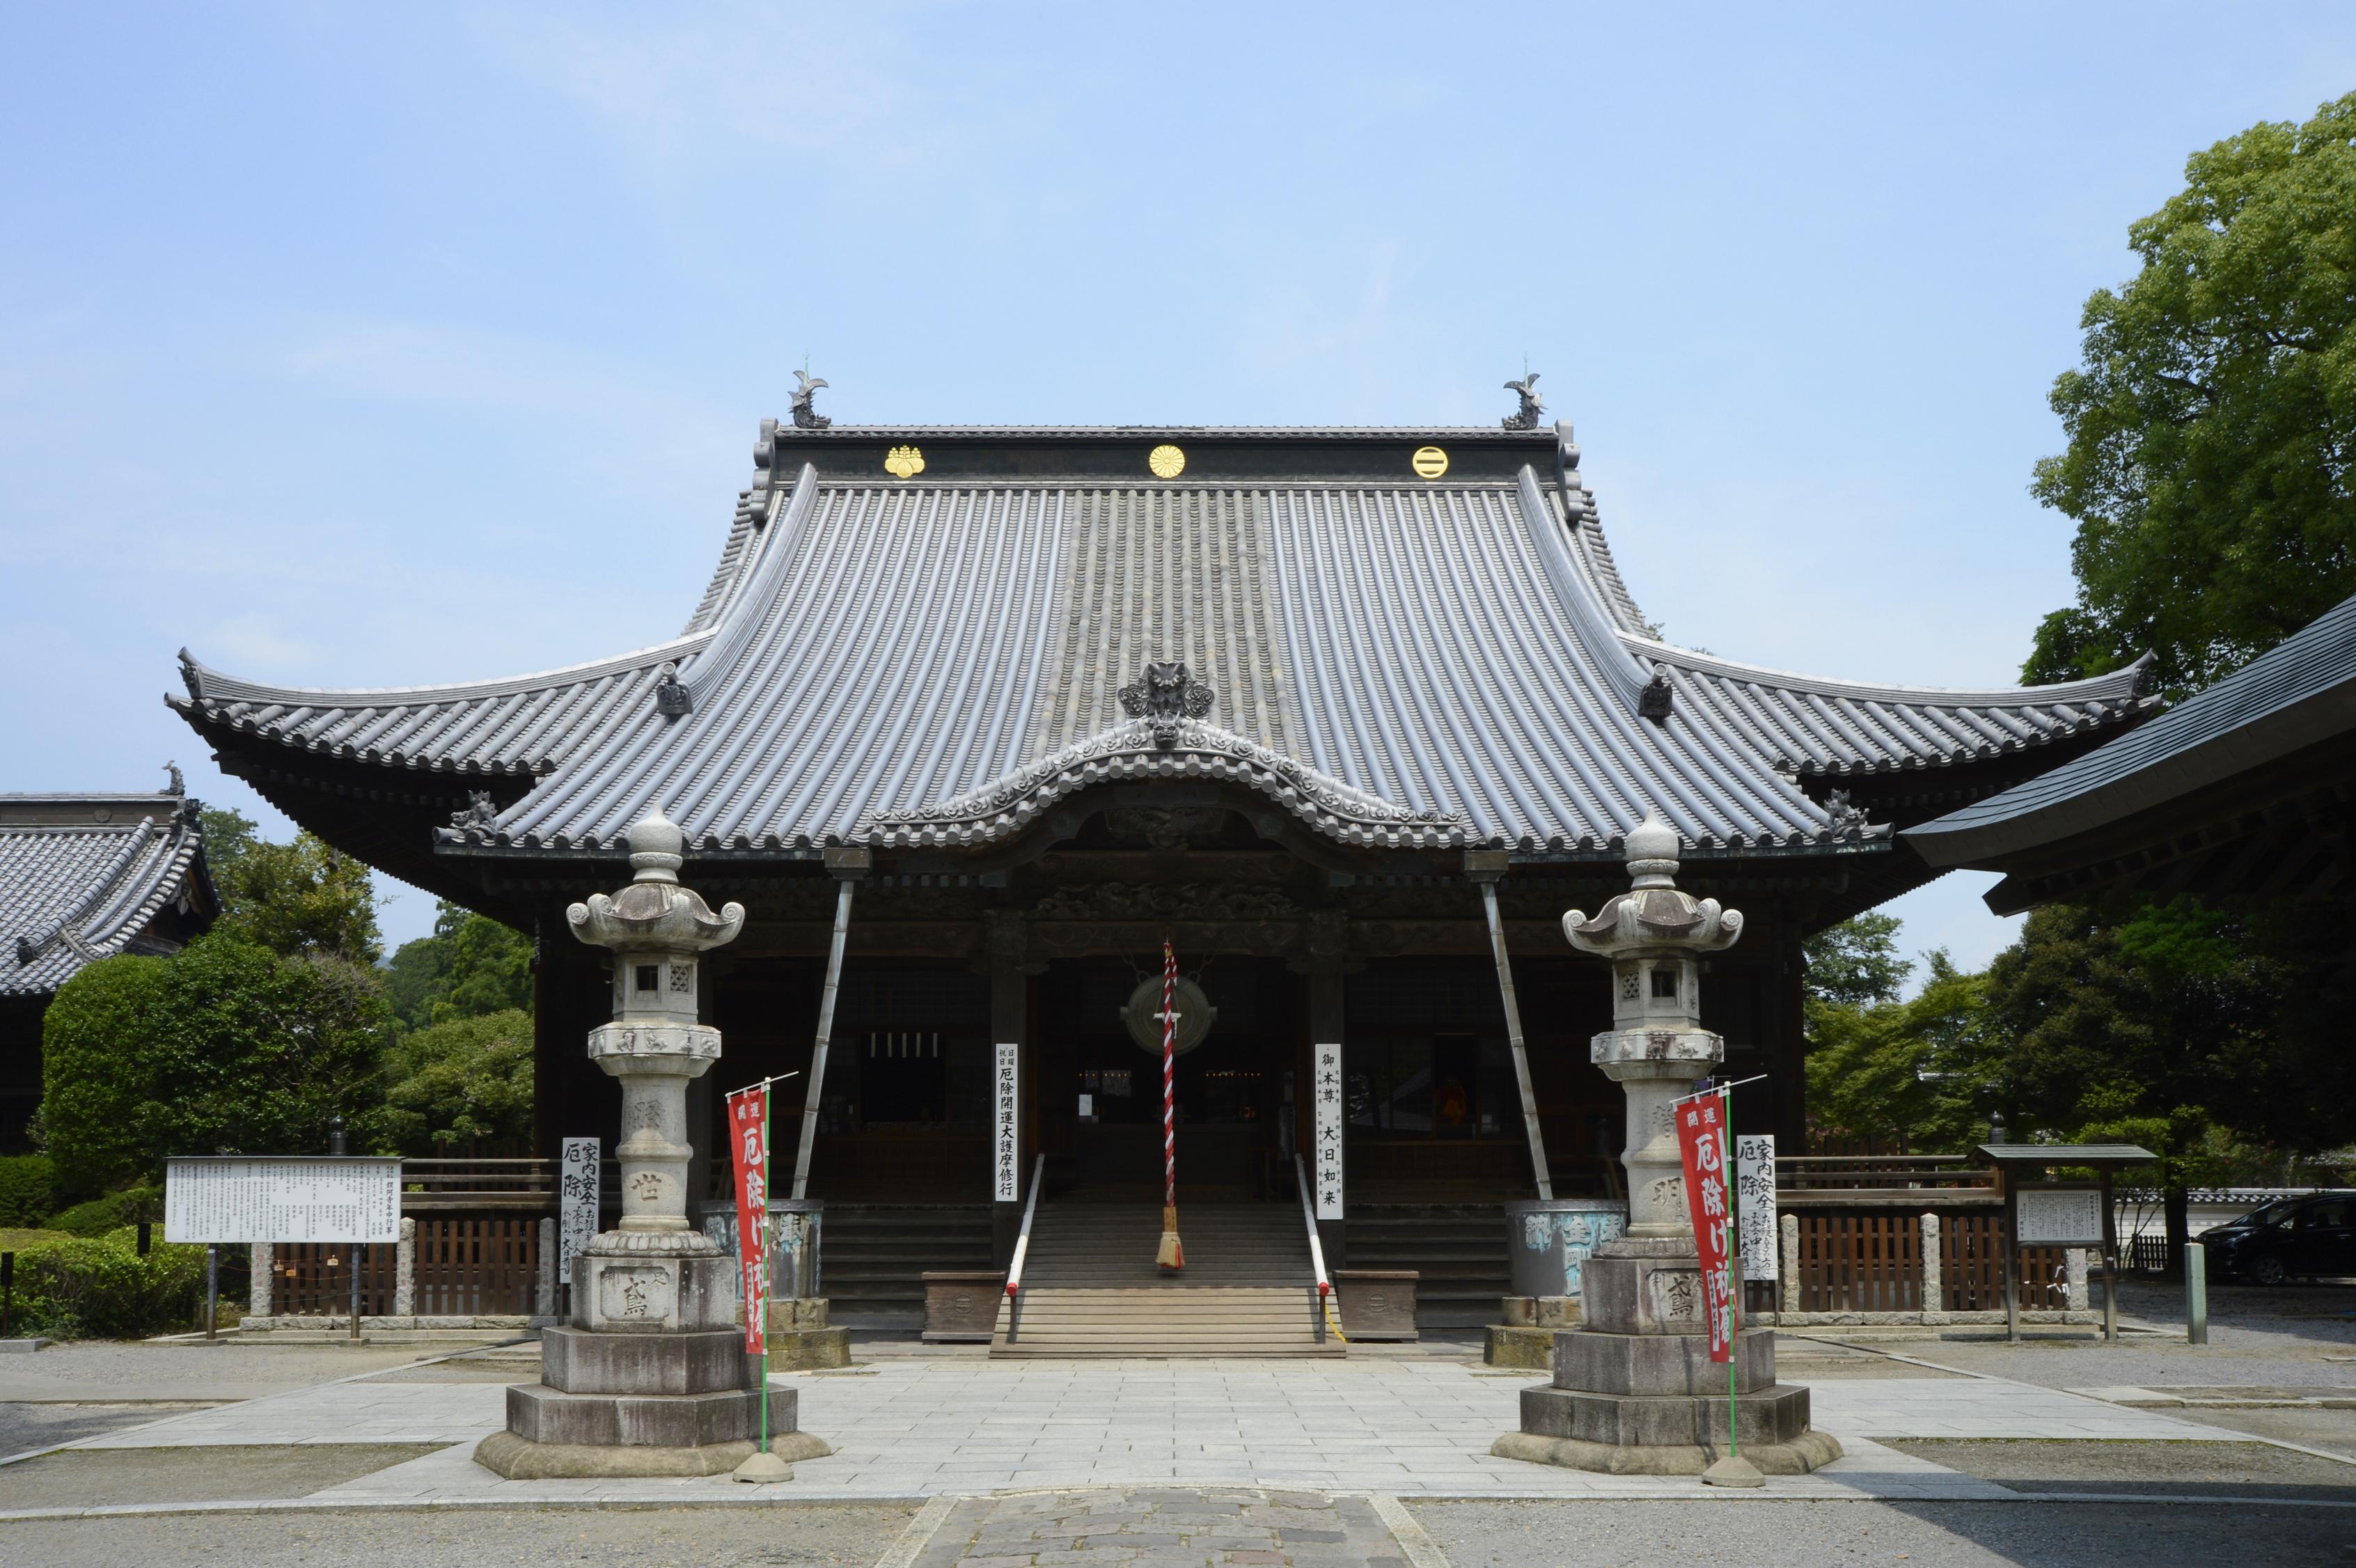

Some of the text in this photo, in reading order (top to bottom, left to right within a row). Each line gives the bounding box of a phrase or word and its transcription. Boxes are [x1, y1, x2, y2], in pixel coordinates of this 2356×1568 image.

[738, 1102, 760, 1120] 開運
[998, 1068, 1014, 1197] 厄除開運大護摩修行
[1321, 1053, 1337, 1206] 御本尊 大日如来
[1687, 1107, 1717, 1127] 開運
[563, 1143, 582, 1198] 厄除
[579, 1142, 597, 1206] 家内安全
[1738, 1140, 1759, 1196] 厄除
[1756, 1139, 1775, 1210] 家内安全
